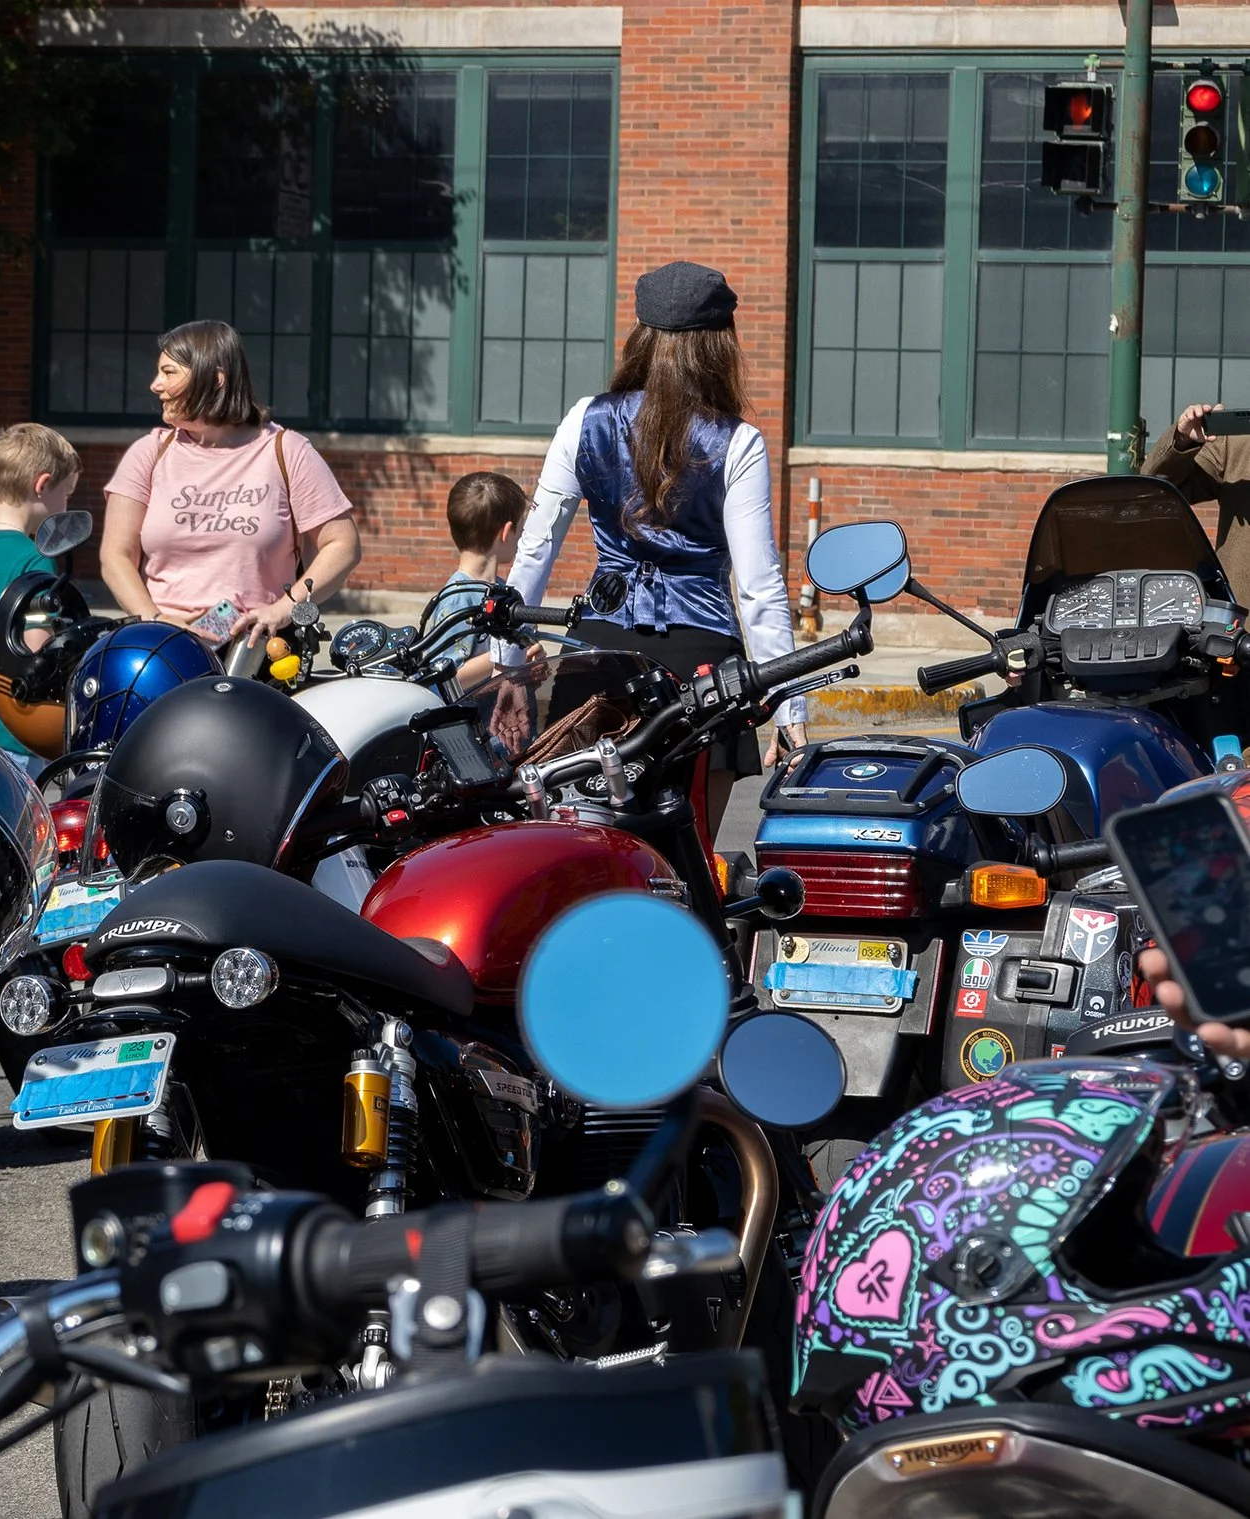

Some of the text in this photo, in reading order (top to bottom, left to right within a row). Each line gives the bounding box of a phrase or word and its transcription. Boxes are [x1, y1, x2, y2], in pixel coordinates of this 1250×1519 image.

[171, 483, 270, 512] Sunday
[175, 511, 260, 536] Vibes
[98, 920, 181, 944] TRIUMPH
[1073, 931, 1109, 945] P C
[811, 940, 857, 953] Illinois
[862, 948, 886, 958] 03 24
[964, 974, 989, 988] agv
[837, 996, 860, 1004] Lincoln
[129, 1041, 145, 1052] 23
[968, 1031, 1011, 1053] BMW MOTORCYCLE
[50, 1046, 118, 1063] Illinois
[964, 1059, 980, 1080] OWNERS
[496, 1082, 521, 1096] SPEED
[58, 1102, 114, 1115] Land of Lincoln
[903, 1440, 984, 1464] TRIUMPH
